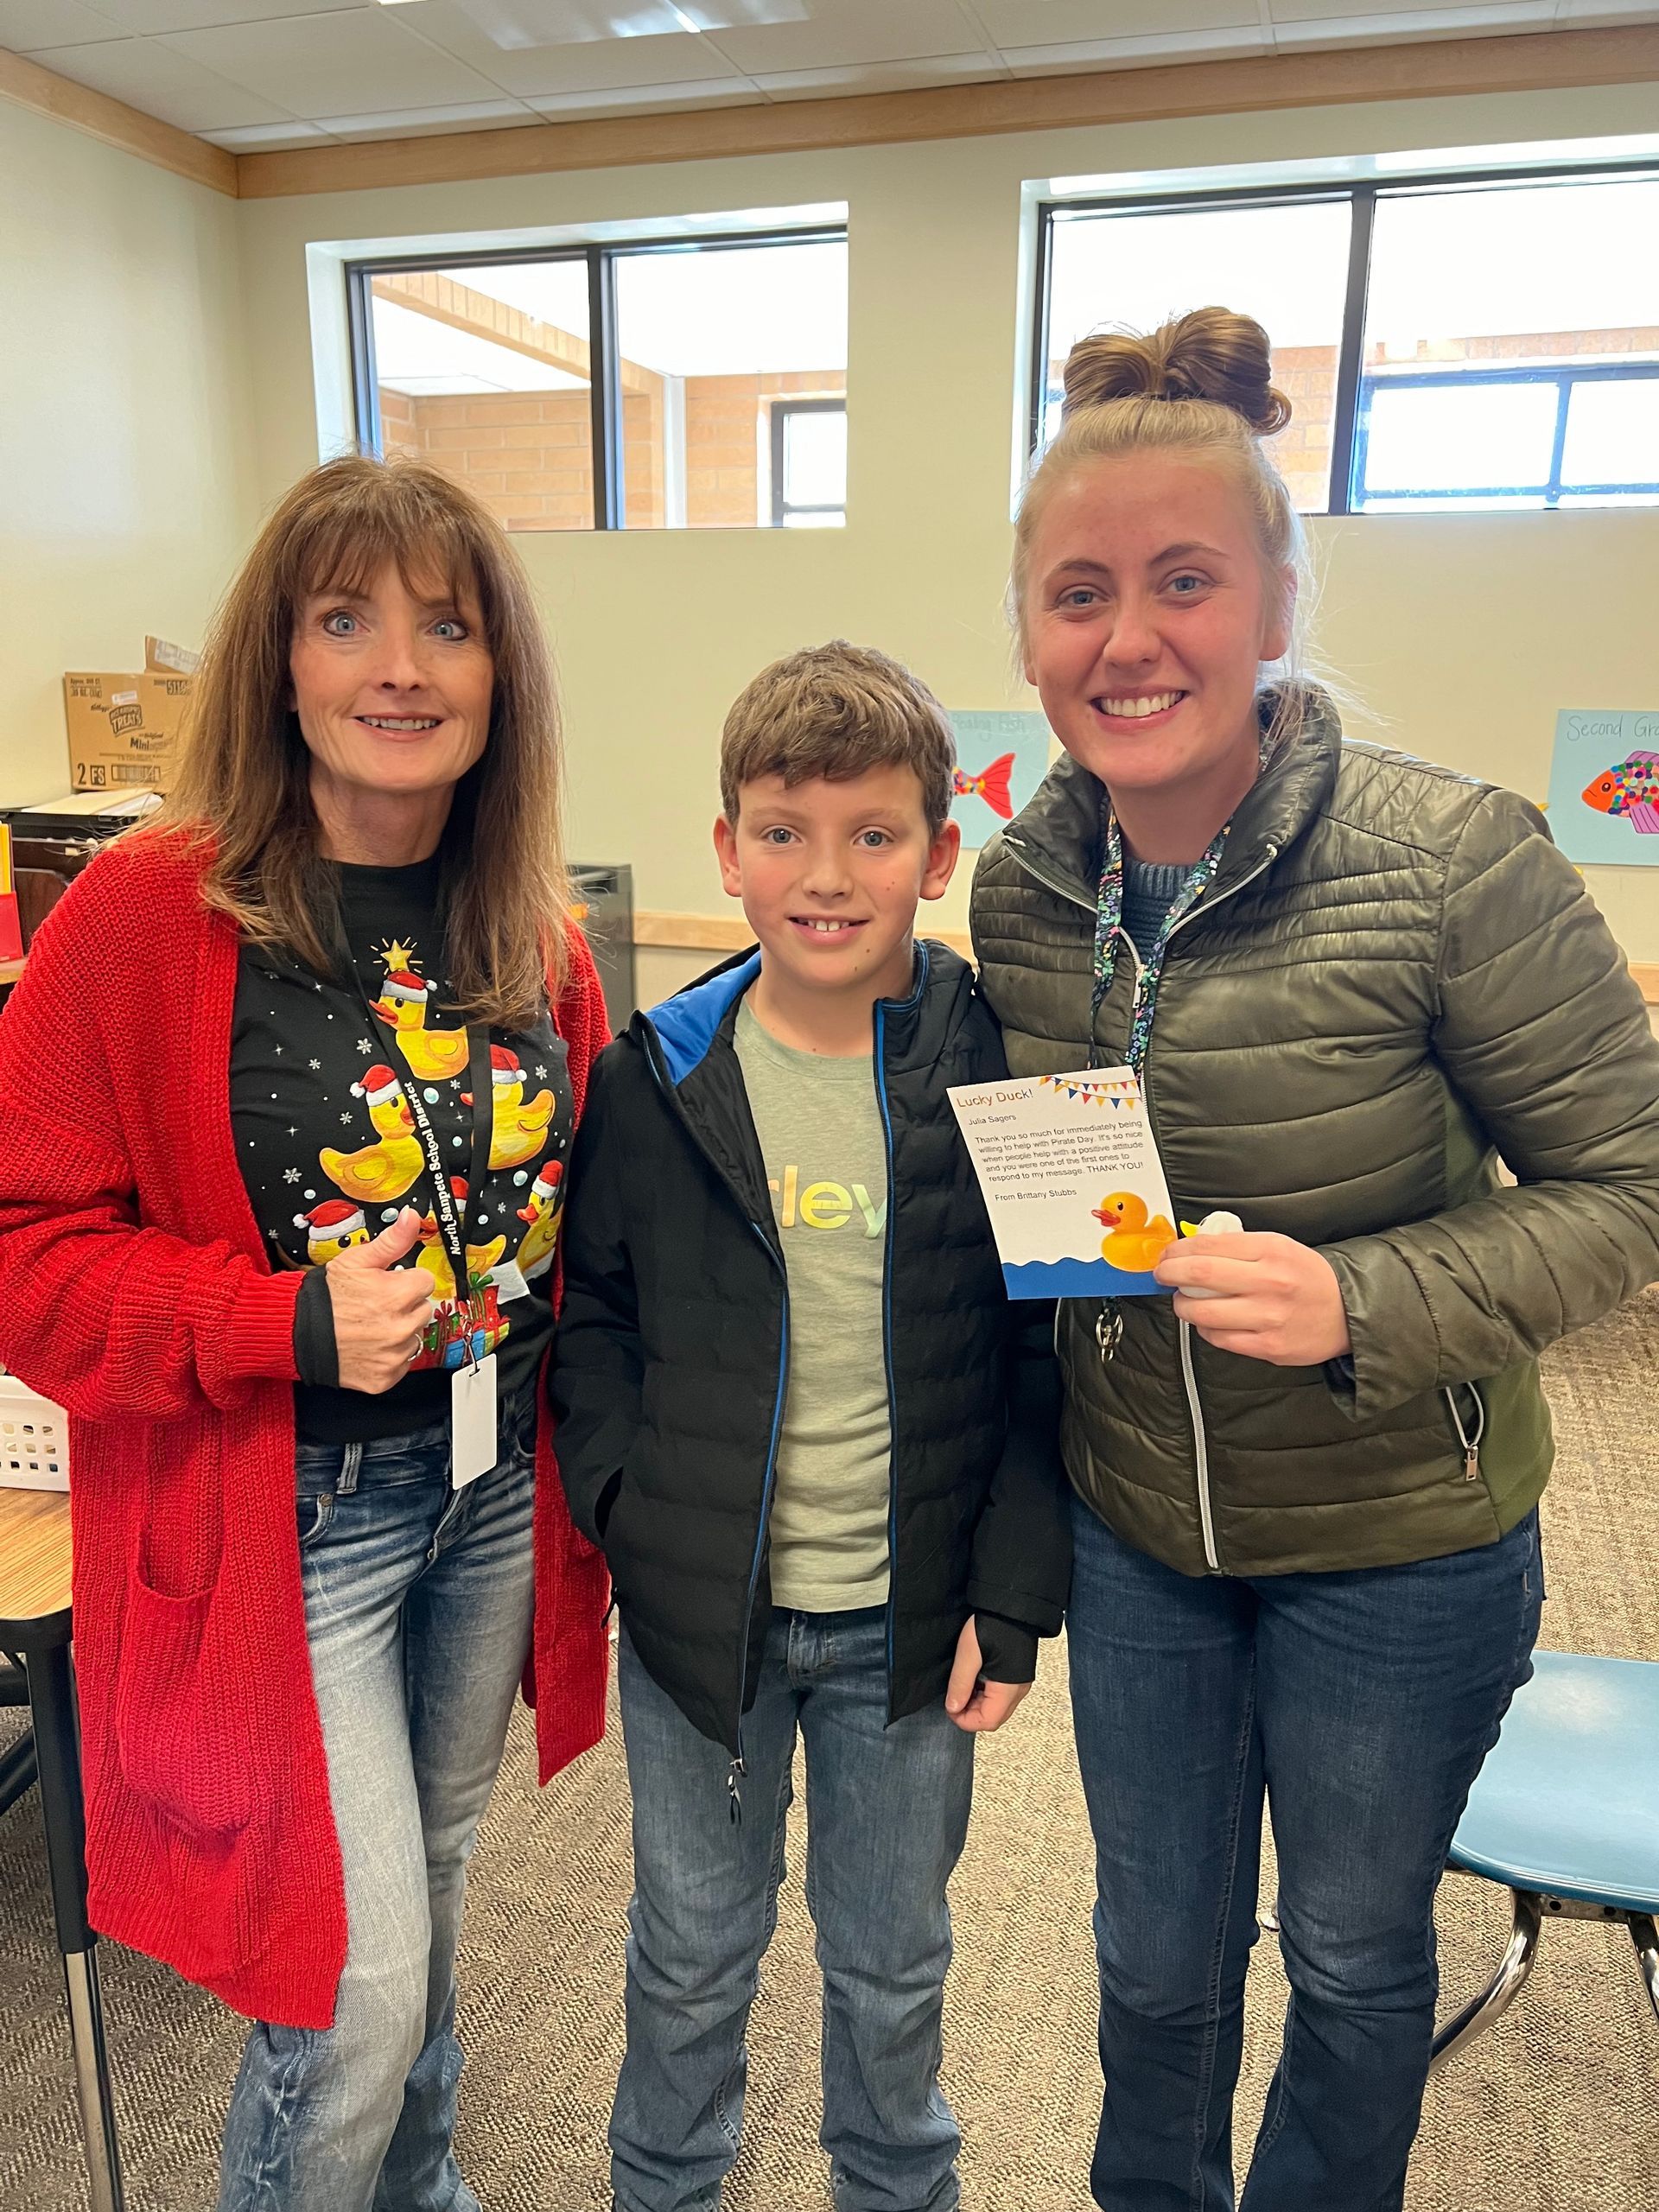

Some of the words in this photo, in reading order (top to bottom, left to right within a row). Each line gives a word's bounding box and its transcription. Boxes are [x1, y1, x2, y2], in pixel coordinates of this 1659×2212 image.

[1567, 715, 1624, 741] Second
[78, 762, 86, 785] 2
[91, 766, 105, 785] FS
[404, 1081, 430, 1128] District
[957, 1095, 992, 1108] Lucky
[995, 1088, 1033, 1103] Duck!
[975, 1135, 1000, 1144] Thank
[1030, 1129, 1052, 1138] much
[1066, 1122, 1116, 1134] immediately
[421, 1128, 442, 1173] School
[1005, 1152, 1032, 1162] people
[1112, 1141, 1143, 1150] attitude
[988, 1173, 1020, 1182] respond
[1089, 1164, 1118, 1173] THANK
[1121, 1161, 1143, 1170] YOU!
[434, 1172, 454, 1223] Sanpete
[1049, 1189, 1077, 1198] Stubbs
[443, 1219, 461, 1255] North
